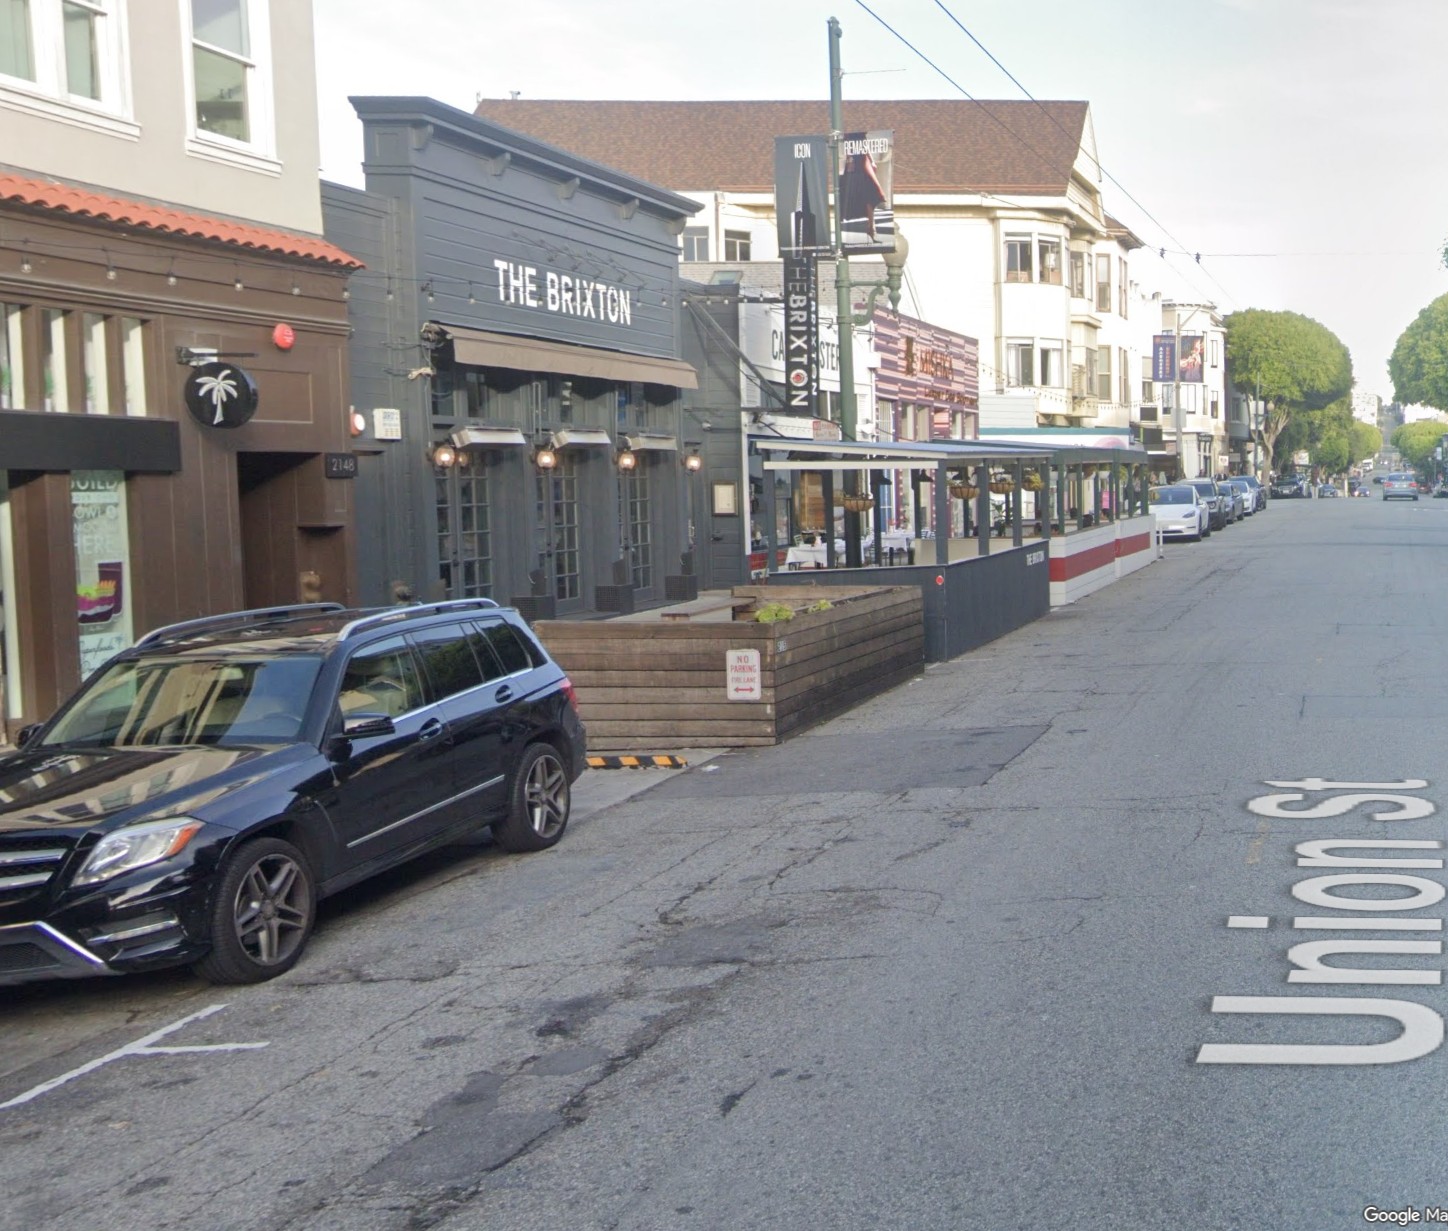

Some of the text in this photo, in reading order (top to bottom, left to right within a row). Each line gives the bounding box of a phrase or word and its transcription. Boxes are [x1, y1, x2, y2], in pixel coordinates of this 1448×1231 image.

[794, 143, 811, 158] ICON
[844, 138, 889, 155] REMASTERED
[494, 259, 632, 326] THE BRIXTON
[789, 294, 808, 406] BRIXTON
[332, 458, 355, 471] 2148
[737, 655, 749, 663] NO
[730, 664, 757, 673] PARKING
